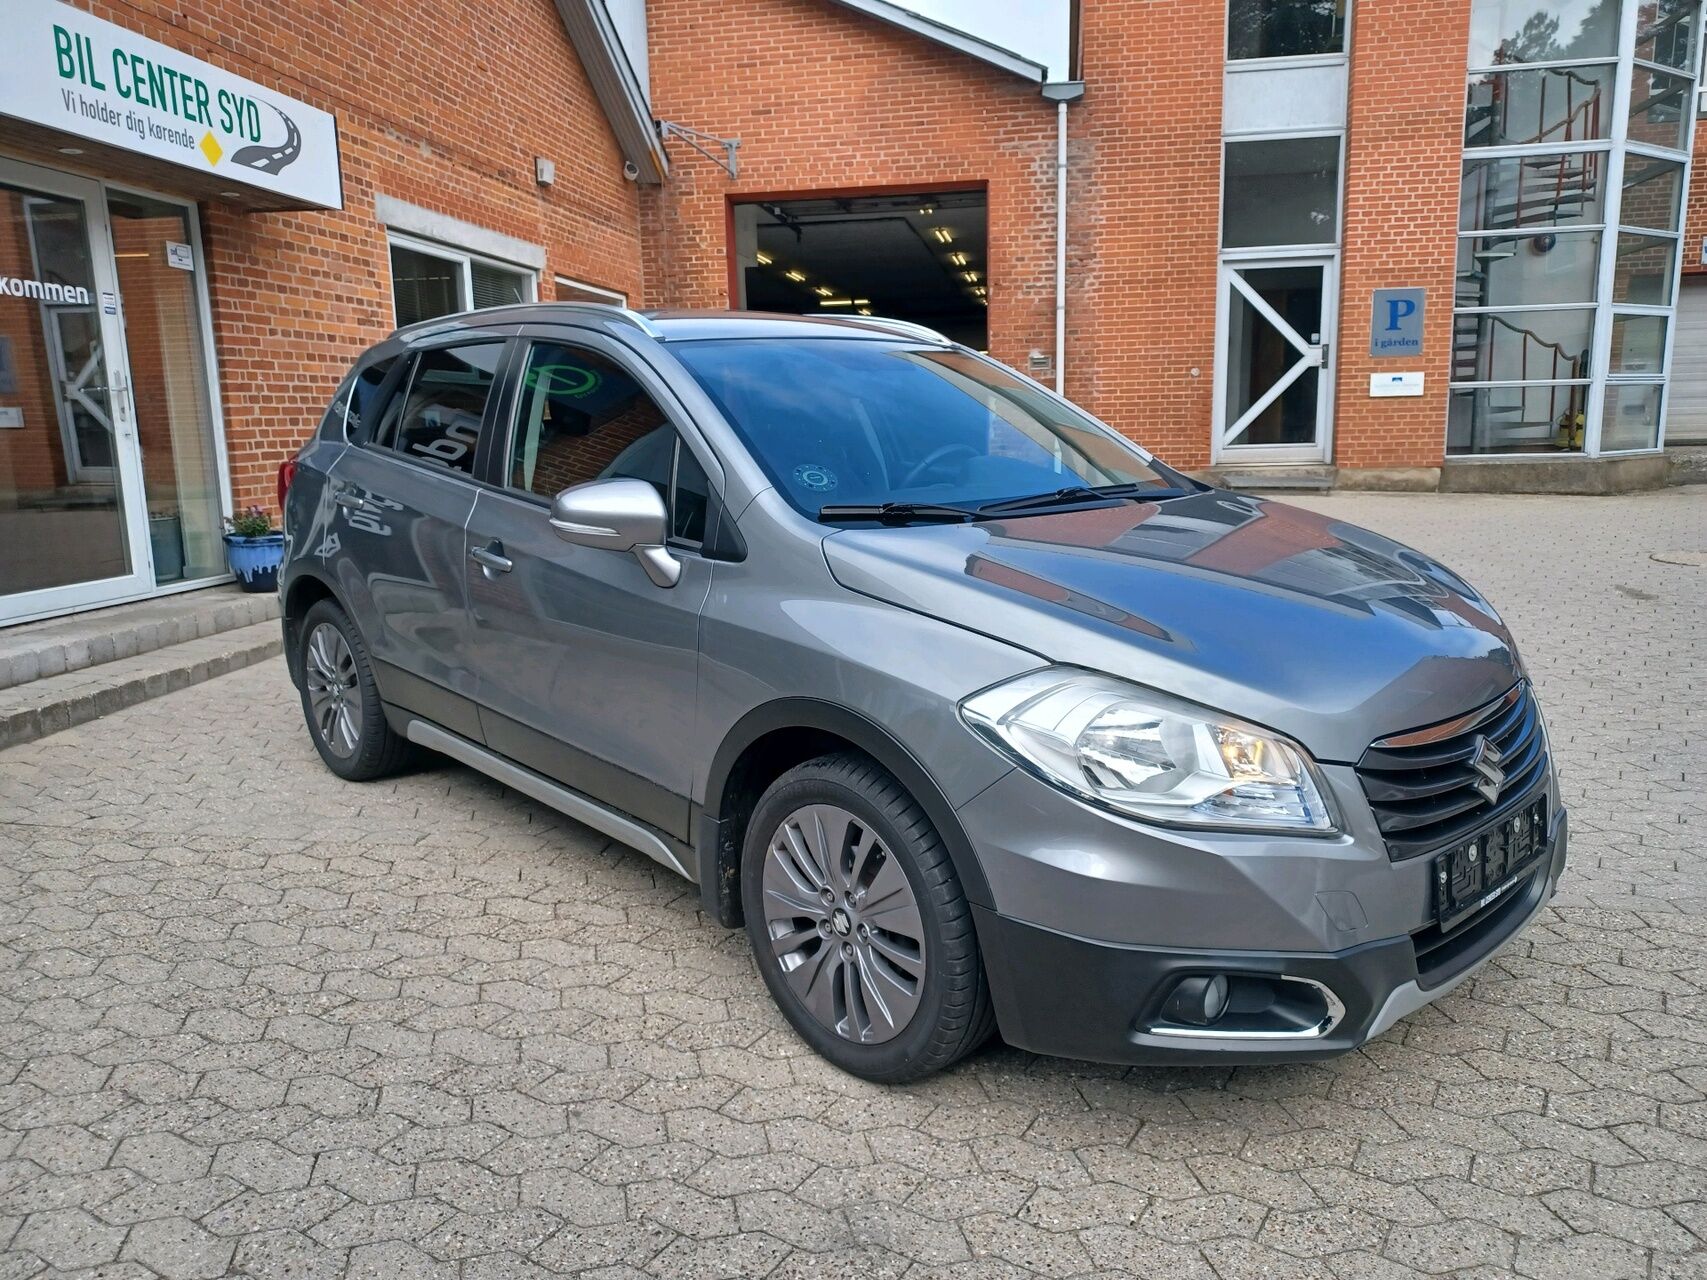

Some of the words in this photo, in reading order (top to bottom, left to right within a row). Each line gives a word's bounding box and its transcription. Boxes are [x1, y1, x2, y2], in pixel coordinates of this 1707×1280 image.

[53, 24, 106, 91] BIL
[112, 48, 213, 128] CENTER
[217, 88, 262, 143] SYD
[61, 87, 77, 113] Vi
[80, 94, 122, 126] holder
[126, 110, 146, 141] dig
[149, 116, 195, 150] kørende
[1385, 299, 1416, 331] P
[1374, 338, 1379, 347] i
[1380, 337, 1419, 349] gården
